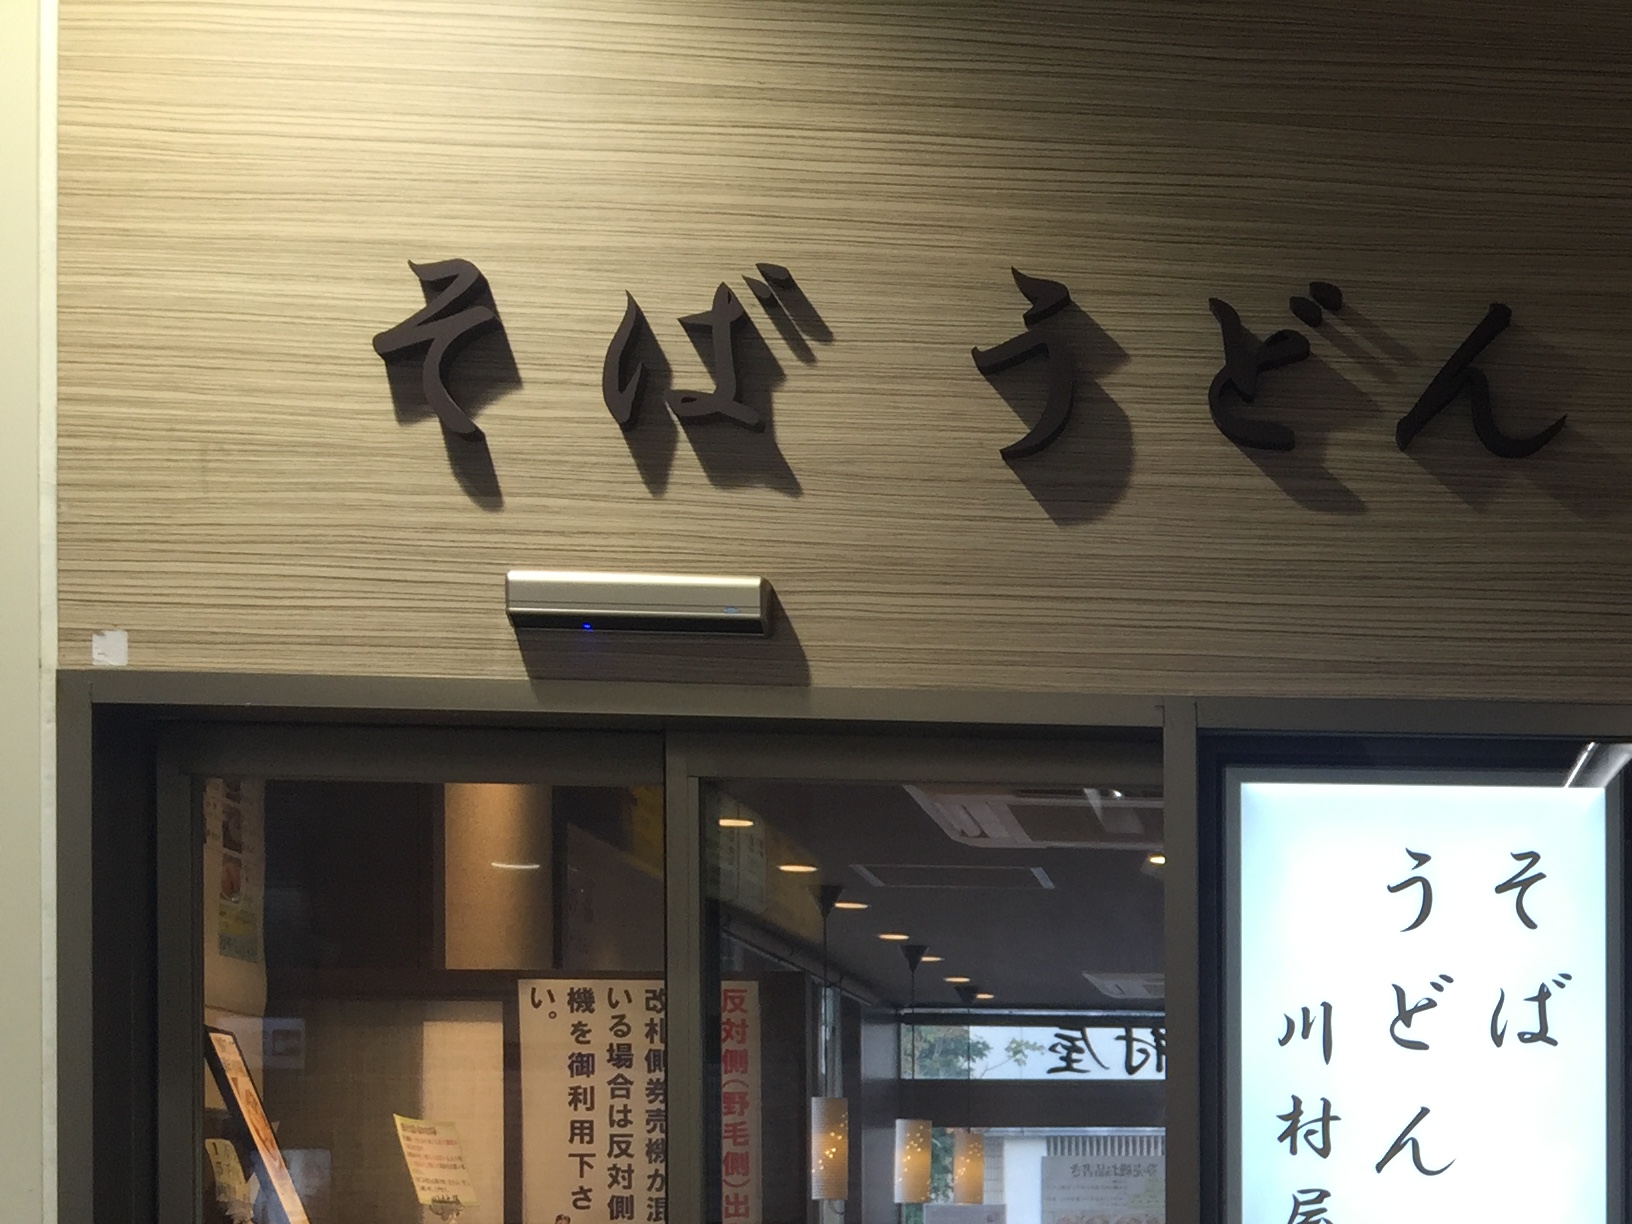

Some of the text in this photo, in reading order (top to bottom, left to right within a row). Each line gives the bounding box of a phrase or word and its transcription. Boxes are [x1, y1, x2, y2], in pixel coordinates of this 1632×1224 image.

[372, 258, 795, 436] そば
[970, 266, 1567, 462] うどん
[1374, 847, 1457, 1177] うどん
[1490, 850, 1573, 1048] そば
[566, 986, 597, 1211] 機を御利用下さ
